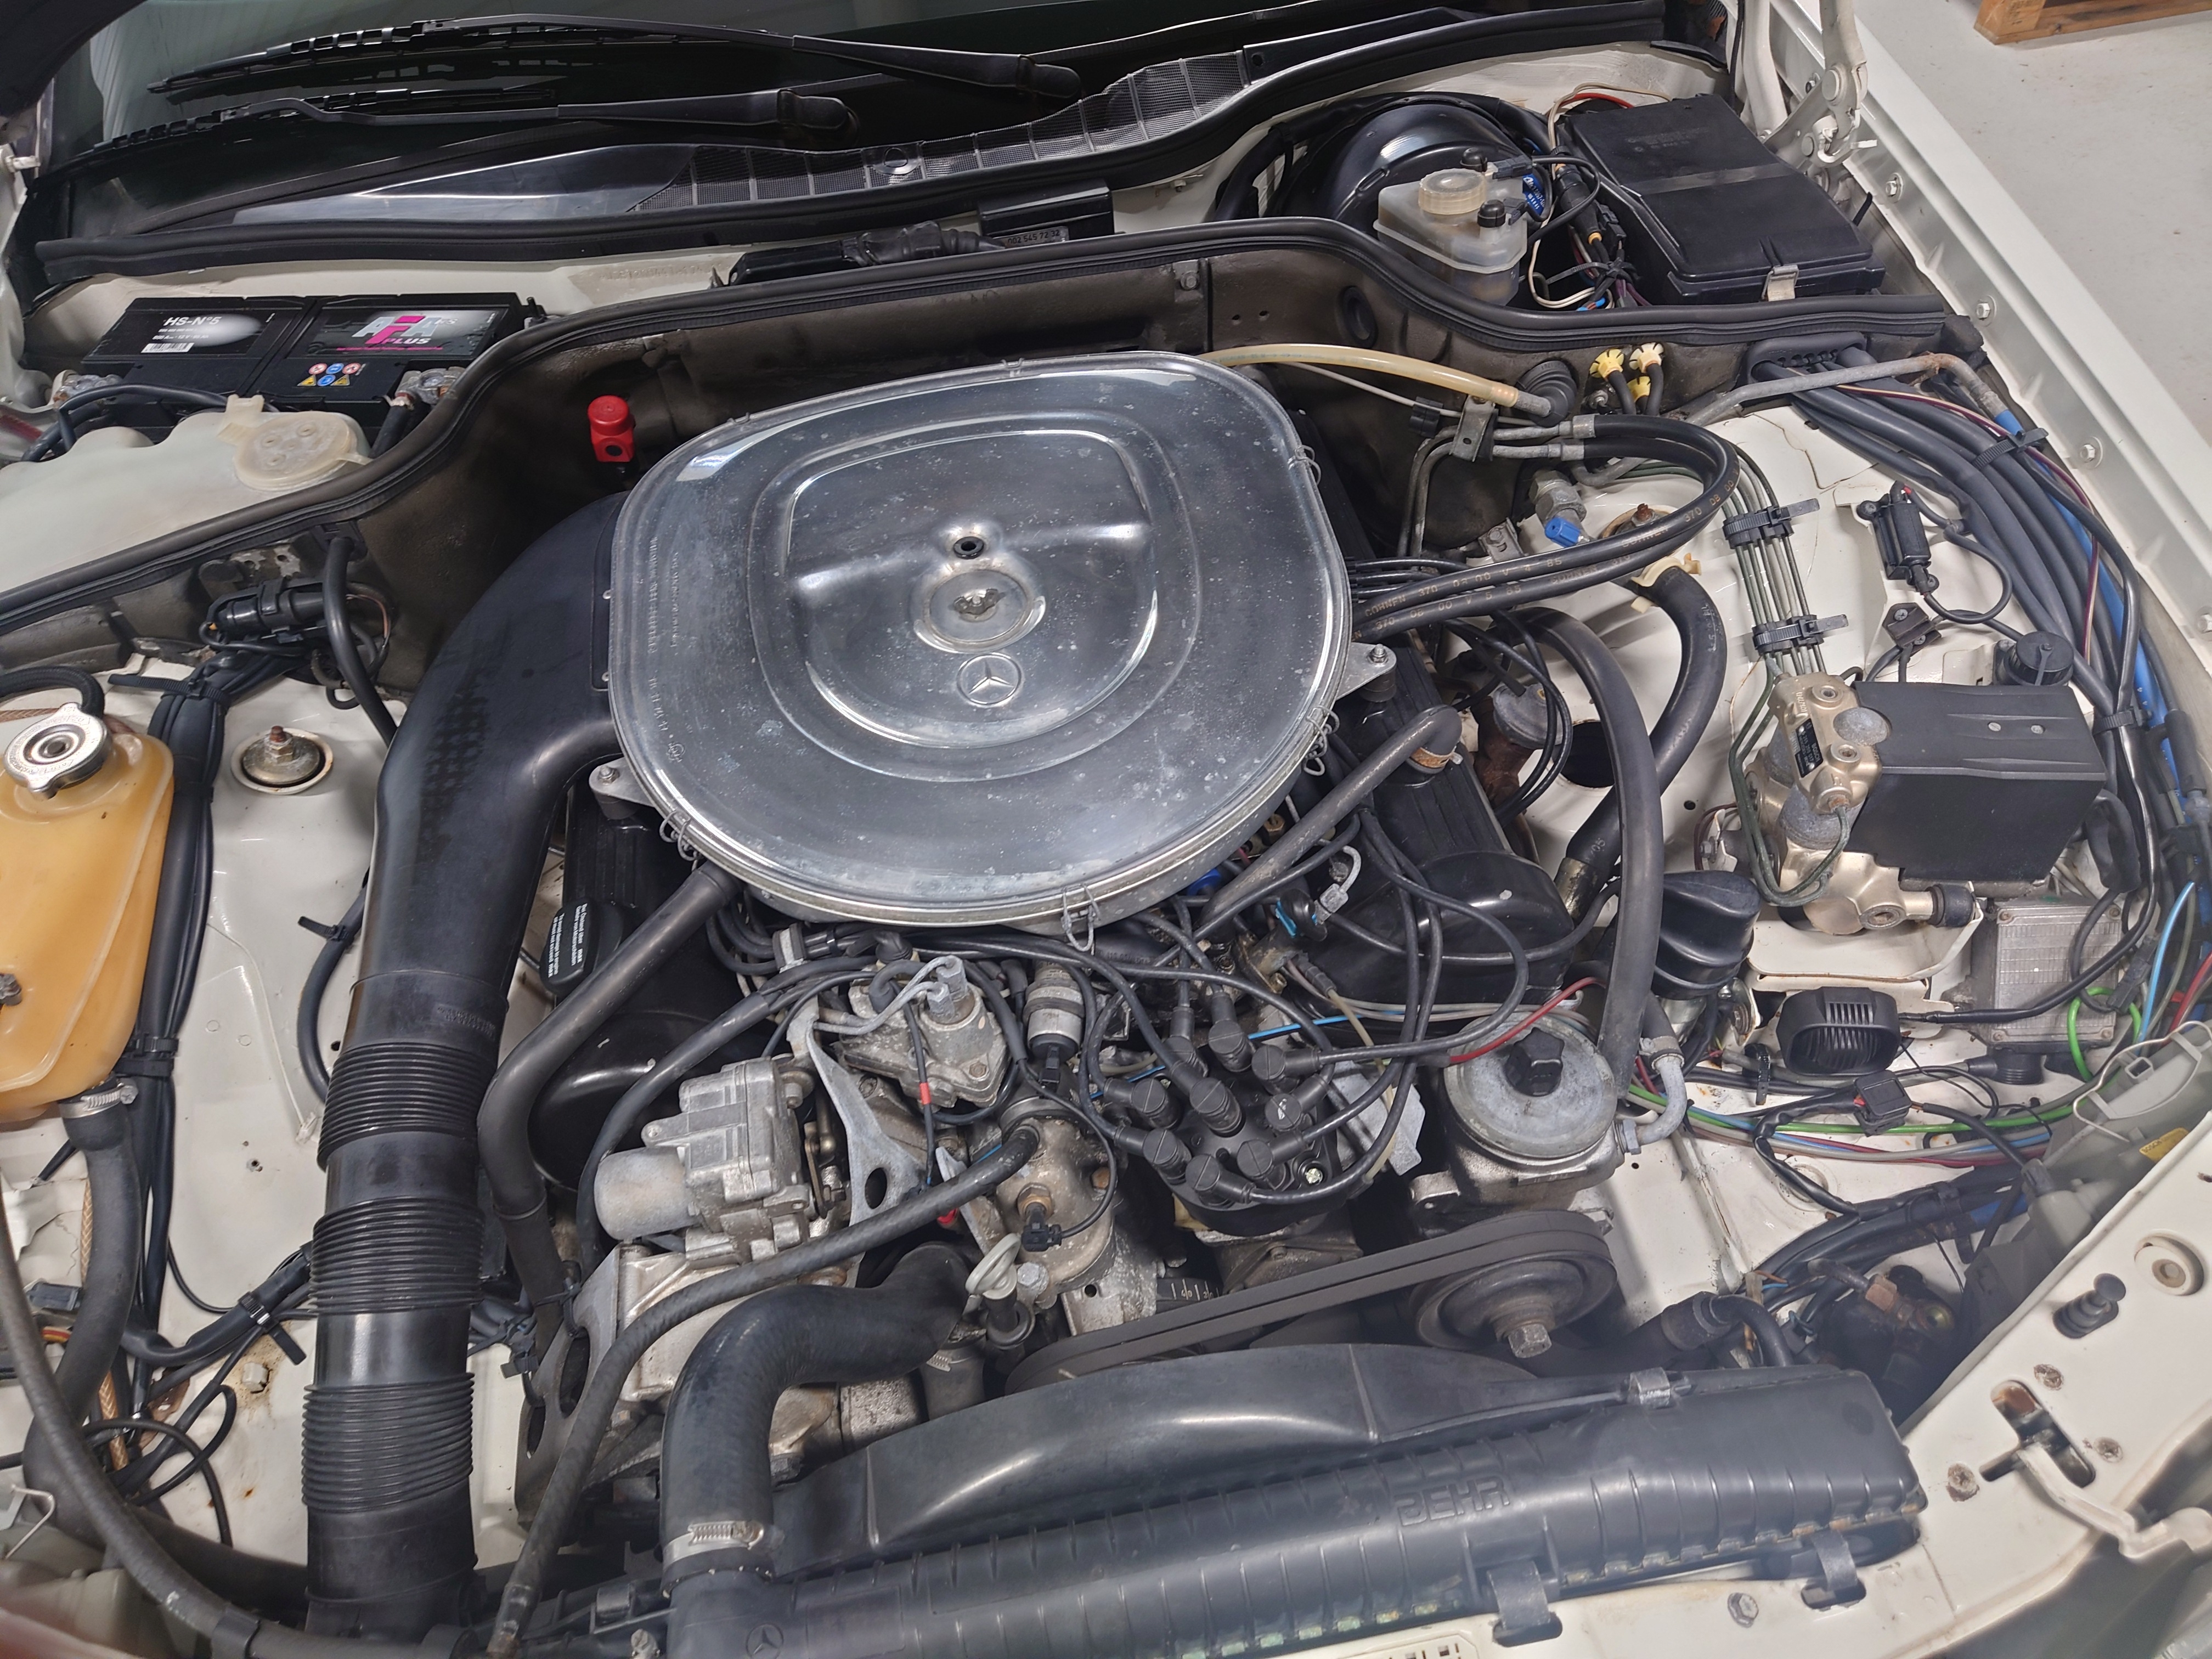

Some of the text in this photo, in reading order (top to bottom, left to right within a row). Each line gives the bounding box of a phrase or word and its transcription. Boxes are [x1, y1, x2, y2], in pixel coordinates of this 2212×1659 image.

[1023, 233, 1037, 242] 545
[1040, 231, 1049, 239] 72
[1683, 507, 1702, 522] 370
[1418, 585, 1438, 597] 370
[1547, 557, 1562, 567] 85
[1375, 616, 1396, 630] 370
[1438, 601, 1453, 611] 00
[1486, 591, 1492, 600] 5
[1506, 585, 1522, 595] 85
[1811, 742, 1821, 763] BOSCH
[2141, 1140, 2163, 1153] BOSCH
[1393, 1476, 1510, 1527] BEHR
